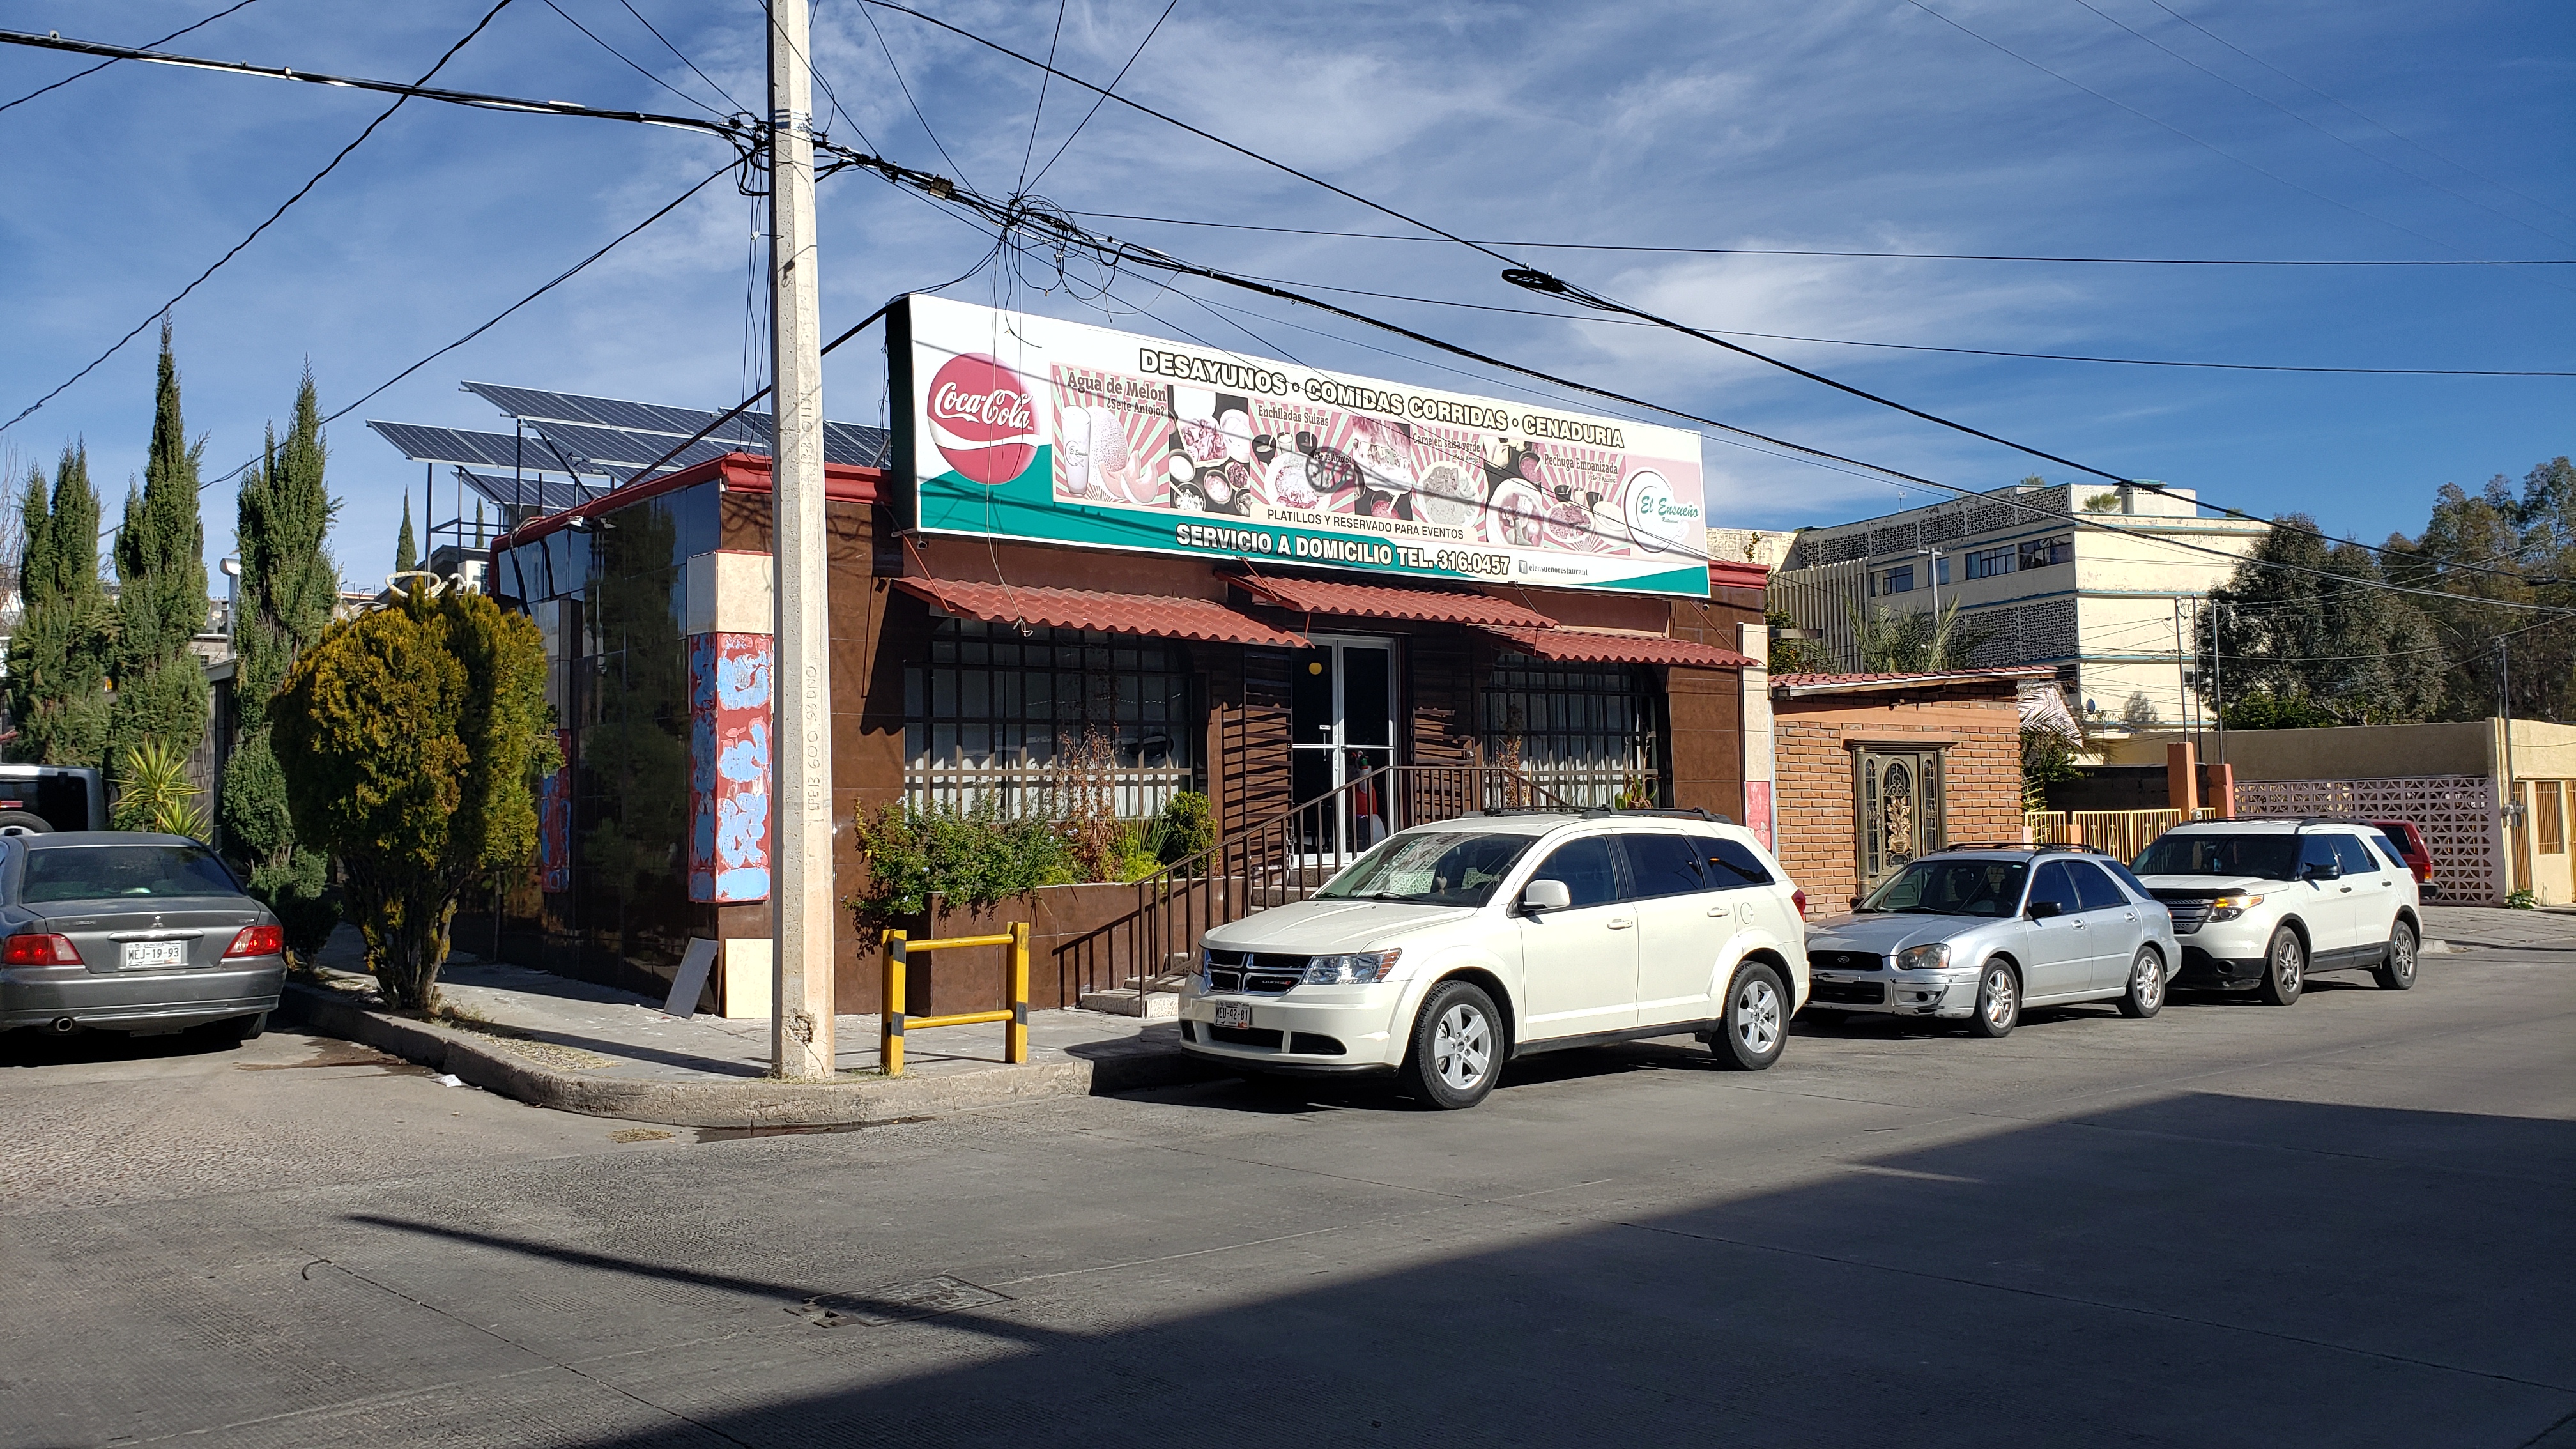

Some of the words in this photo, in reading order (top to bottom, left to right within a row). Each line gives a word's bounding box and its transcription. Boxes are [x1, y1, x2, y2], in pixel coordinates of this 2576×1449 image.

[1068, 372, 1102, 392] Agua
[1107, 377, 1123, 395] de
[1126, 381, 1166, 402] Melon
[1140, 348, 1287, 395] DESAYUNOS
[1305, 378, 1404, 415] COMIDAS
[1408, 396, 1508, 431] CORRIDAS
[1522, 414, 1625, 448] CENADURIA
[934, 382, 1034, 429] Coca-Cola
[1123, 401, 1132, 412] te
[1134, 402, 1165, 418] Antojo?
[1258, 405, 1302, 423] Enchiladas
[1304, 411, 1330, 427] Suizas
[1413, 433, 1432, 446] Carne
[1433, 438, 1443, 447] en
[1445, 438, 1460, 450] salsa
[1462, 441, 1480, 452] verde
[1544, 453, 1574, 473] Pechuga
[1575, 459, 1618, 475] Empanizada
[1640, 496, 1653, 514] El
[1658, 498, 1699, 518] Ensueño
[1268, 509, 1322, 524] PLATILLOS
[1324, 515, 1331, 525] Y
[1333, 517, 1392, 533] RESERVADO
[1395, 523, 1420, 535] PARA
[1422, 526, 1464, 539] EVENTOS
[1176, 523, 1273, 553] SERVICIO
[1276, 533, 1292, 555] A
[1295, 535, 1393, 565] DOMICILIO
[1396, 546, 1434, 568] TEL.
[1438, 549, 1510, 575] 316.0457
[128, 947, 179, 960] WEJ-19-93
